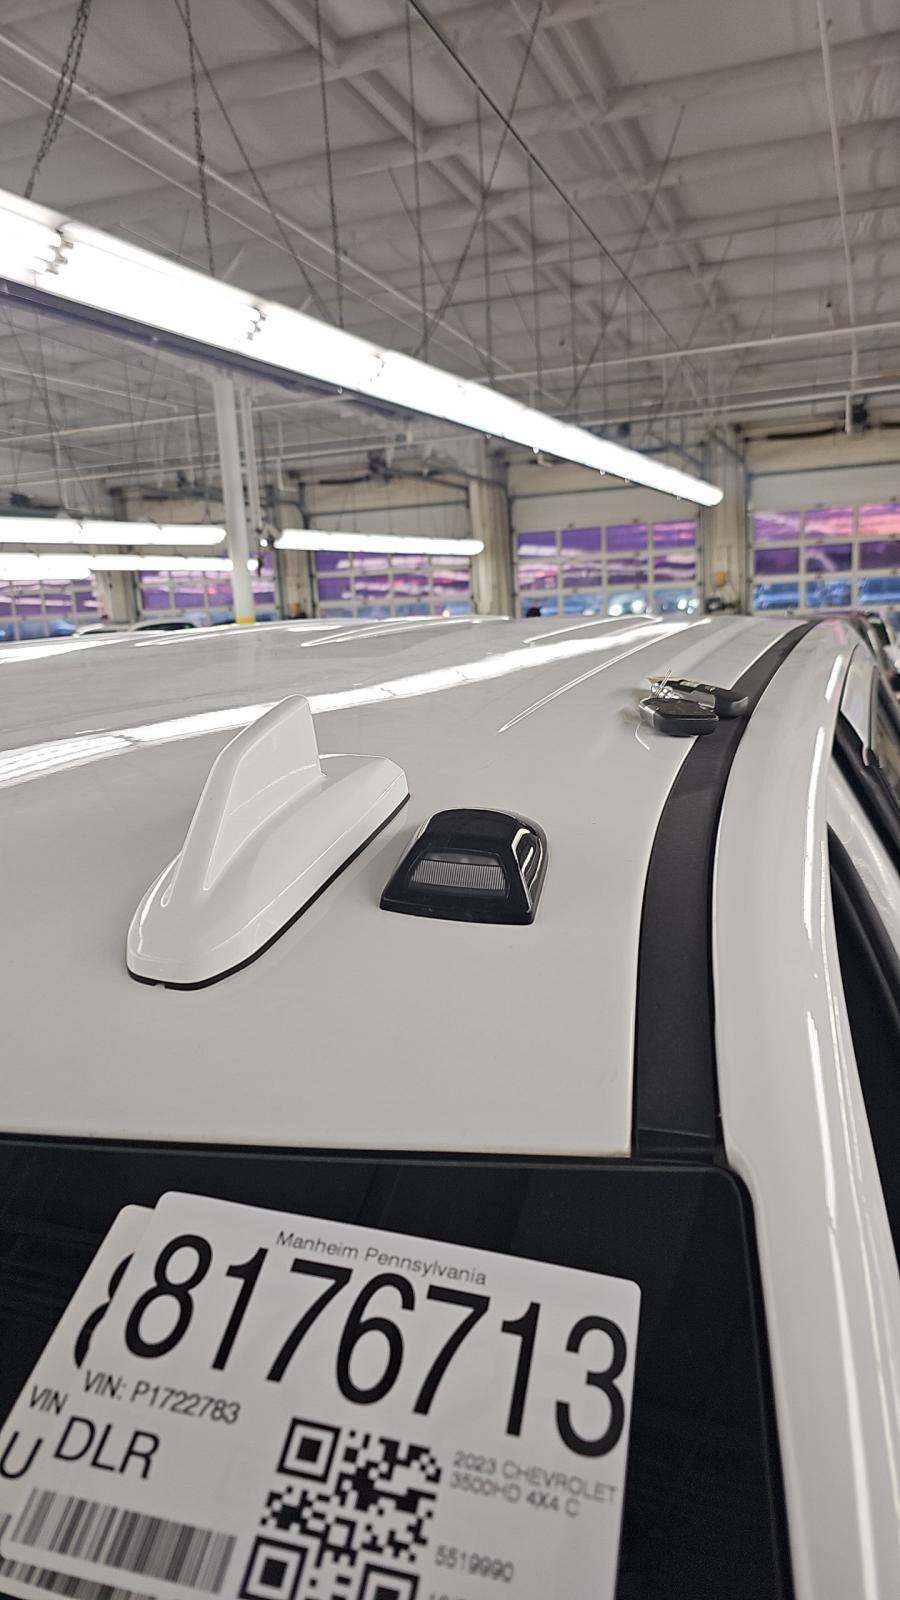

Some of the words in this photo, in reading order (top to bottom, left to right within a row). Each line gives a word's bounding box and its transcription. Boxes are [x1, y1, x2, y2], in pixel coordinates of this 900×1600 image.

[276, 1231, 359, 1259] Manheim
[364, 1247, 487, 1286] Pennsylvania
[125, 1234, 627, 1458] 8176713
[29, 1385, 68, 1415] VIN
[84, 1369, 127, 1400] VIN:
[131, 1380, 241, 1425] P1722783
[0, 1431, 43, 1479] U
[53, 1416, 160, 1479] DLR
[451, 1471, 521, 1503] 3500HD
[526, 1490, 559, 1511] 4X4
[453, 1450, 497, 1475] 2023
[502, 1459, 617, 1503] CHEVROLET
